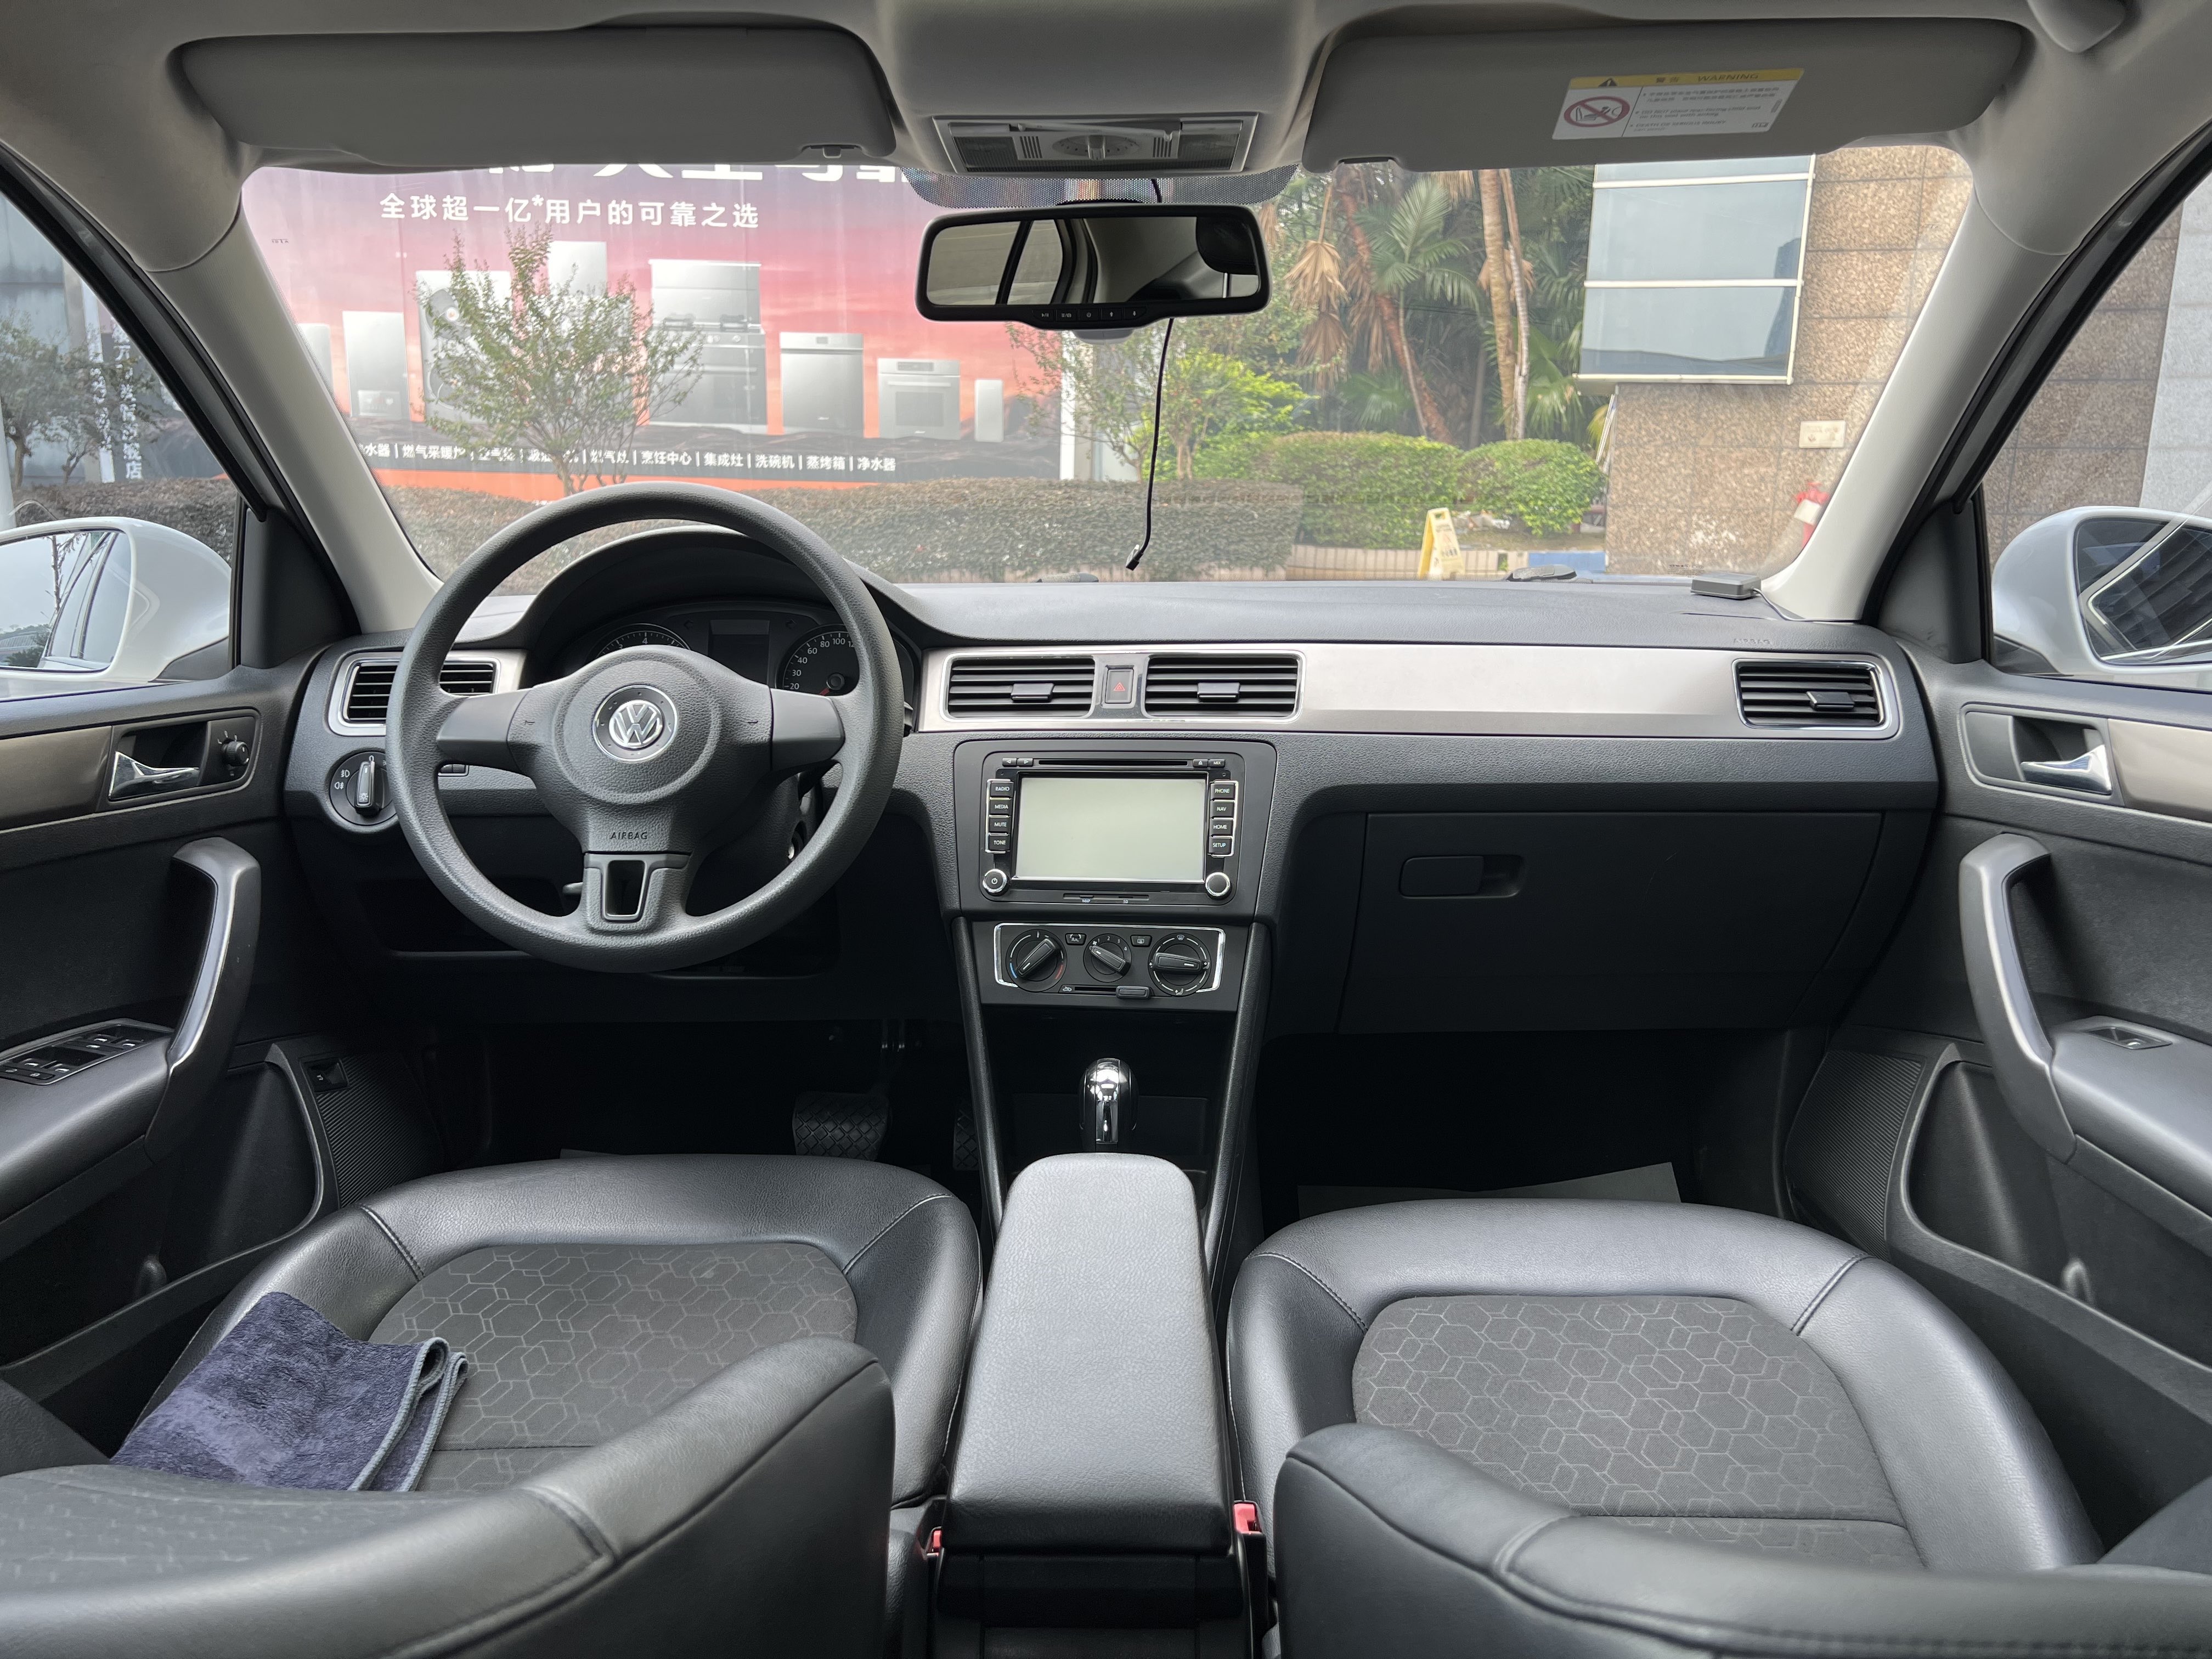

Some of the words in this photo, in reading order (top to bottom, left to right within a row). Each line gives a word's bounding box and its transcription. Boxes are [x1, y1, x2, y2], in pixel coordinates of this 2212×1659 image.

[1697, 73, 1759, 83] WARNING
[641, 450, 692, 465] 烹饪中心
[703, 452, 744, 467] 集成灶
[755, 454, 795, 469] 洗碗机
[806, 455, 846, 470] 蒸烤箱
[857, 456, 896, 471] 净水器
[610, 831, 648, 840] AIRBAG
